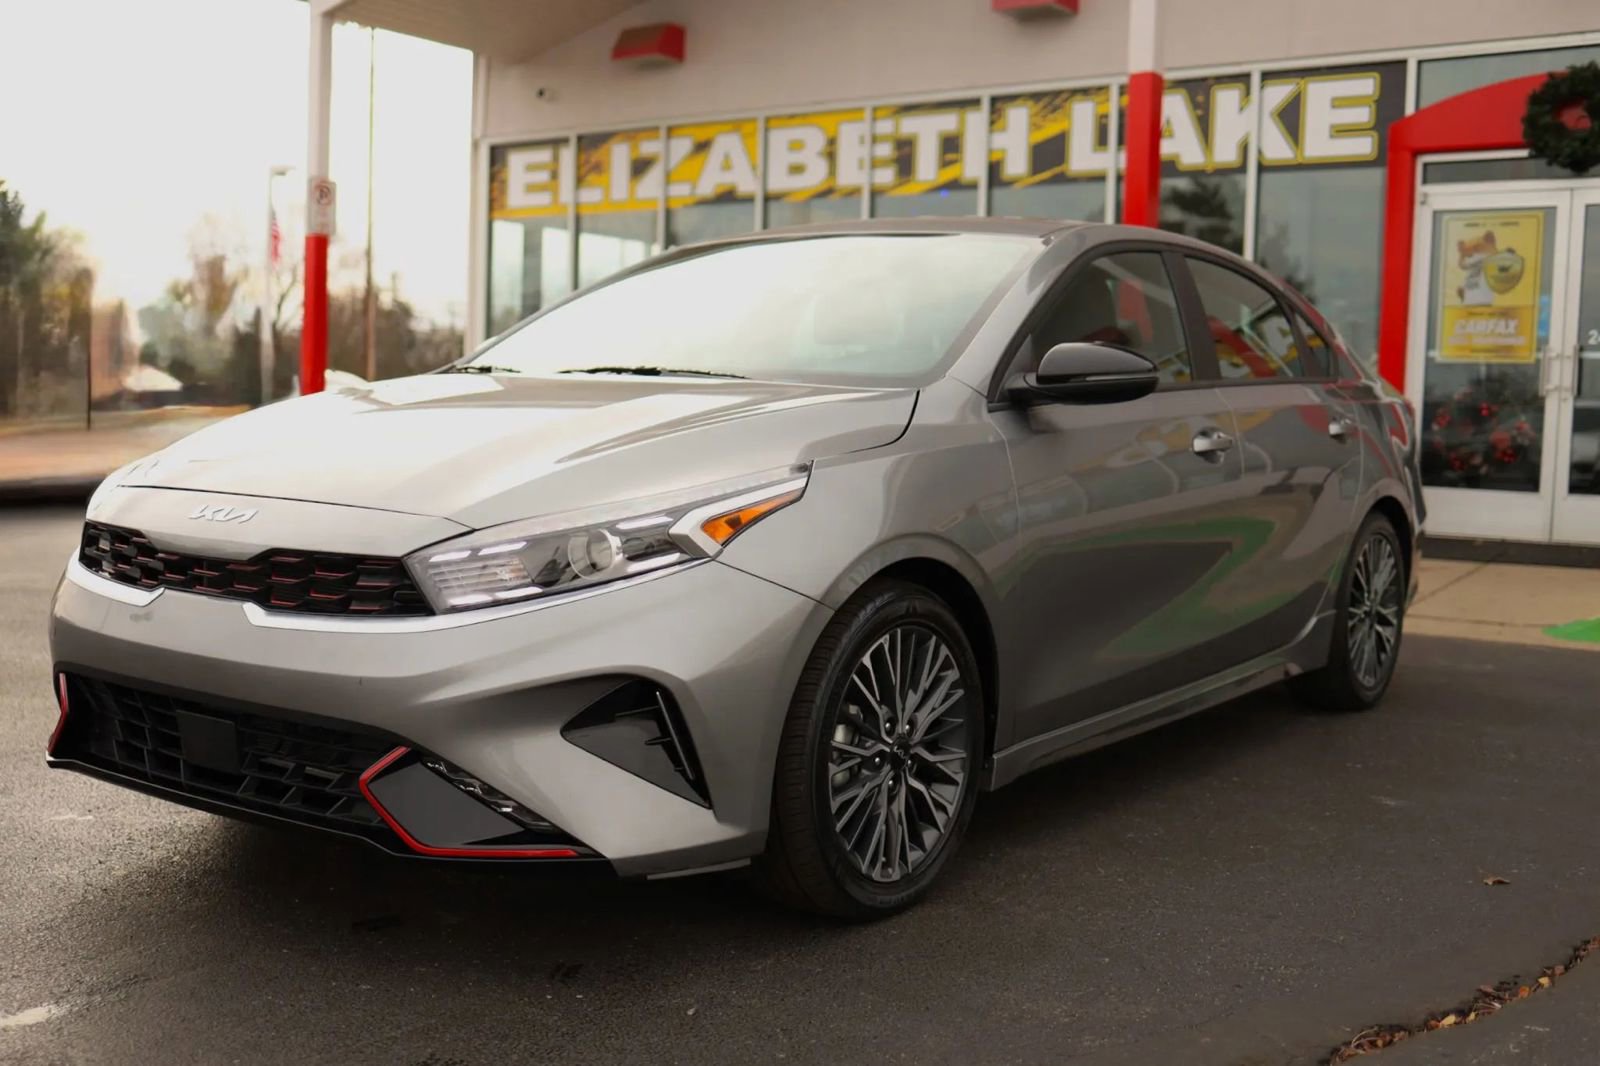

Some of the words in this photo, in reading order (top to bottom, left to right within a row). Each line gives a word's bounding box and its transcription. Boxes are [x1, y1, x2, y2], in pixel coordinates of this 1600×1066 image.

[505, 104, 1031, 209] ELIZABETH
[1067, 73, 1380, 176] LAKE
[1588, 329, 1600, 345] 2
